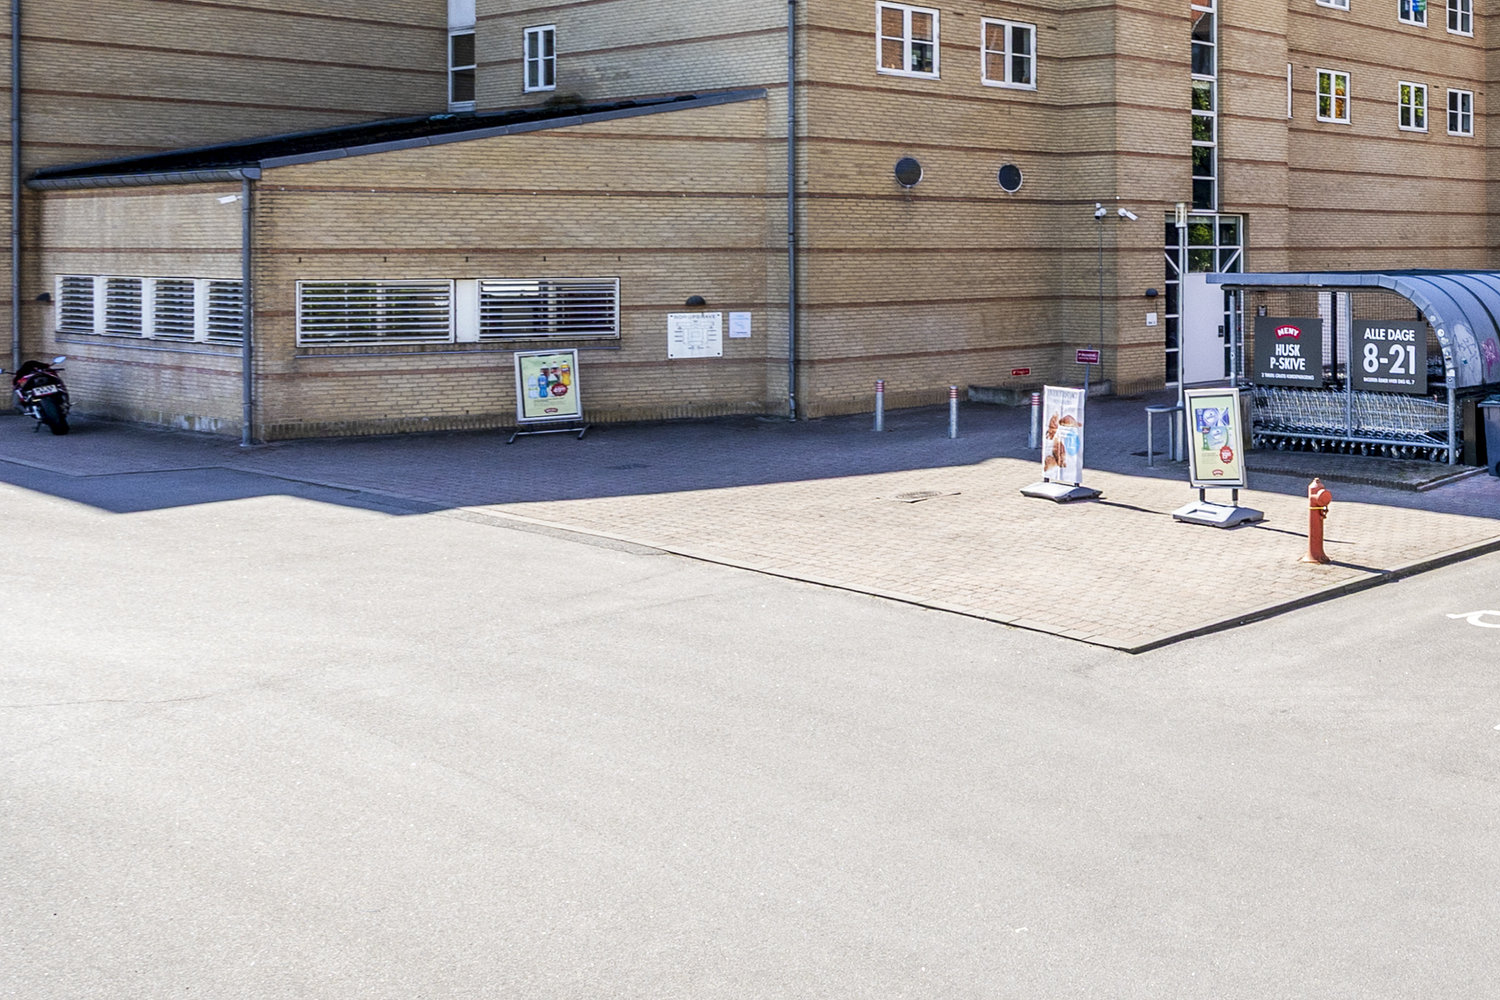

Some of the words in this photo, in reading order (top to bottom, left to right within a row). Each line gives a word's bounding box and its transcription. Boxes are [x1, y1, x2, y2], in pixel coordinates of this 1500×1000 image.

[1277, 327, 1299, 336] MENY
[1363, 328, 1386, 340] ALLE
[1387, 329, 1415, 341] DAGE
[1275, 343, 1301, 356] HUSK
[1270, 356, 1306, 370] P-SKIVE
[1363, 343, 1416, 375] 8-21
